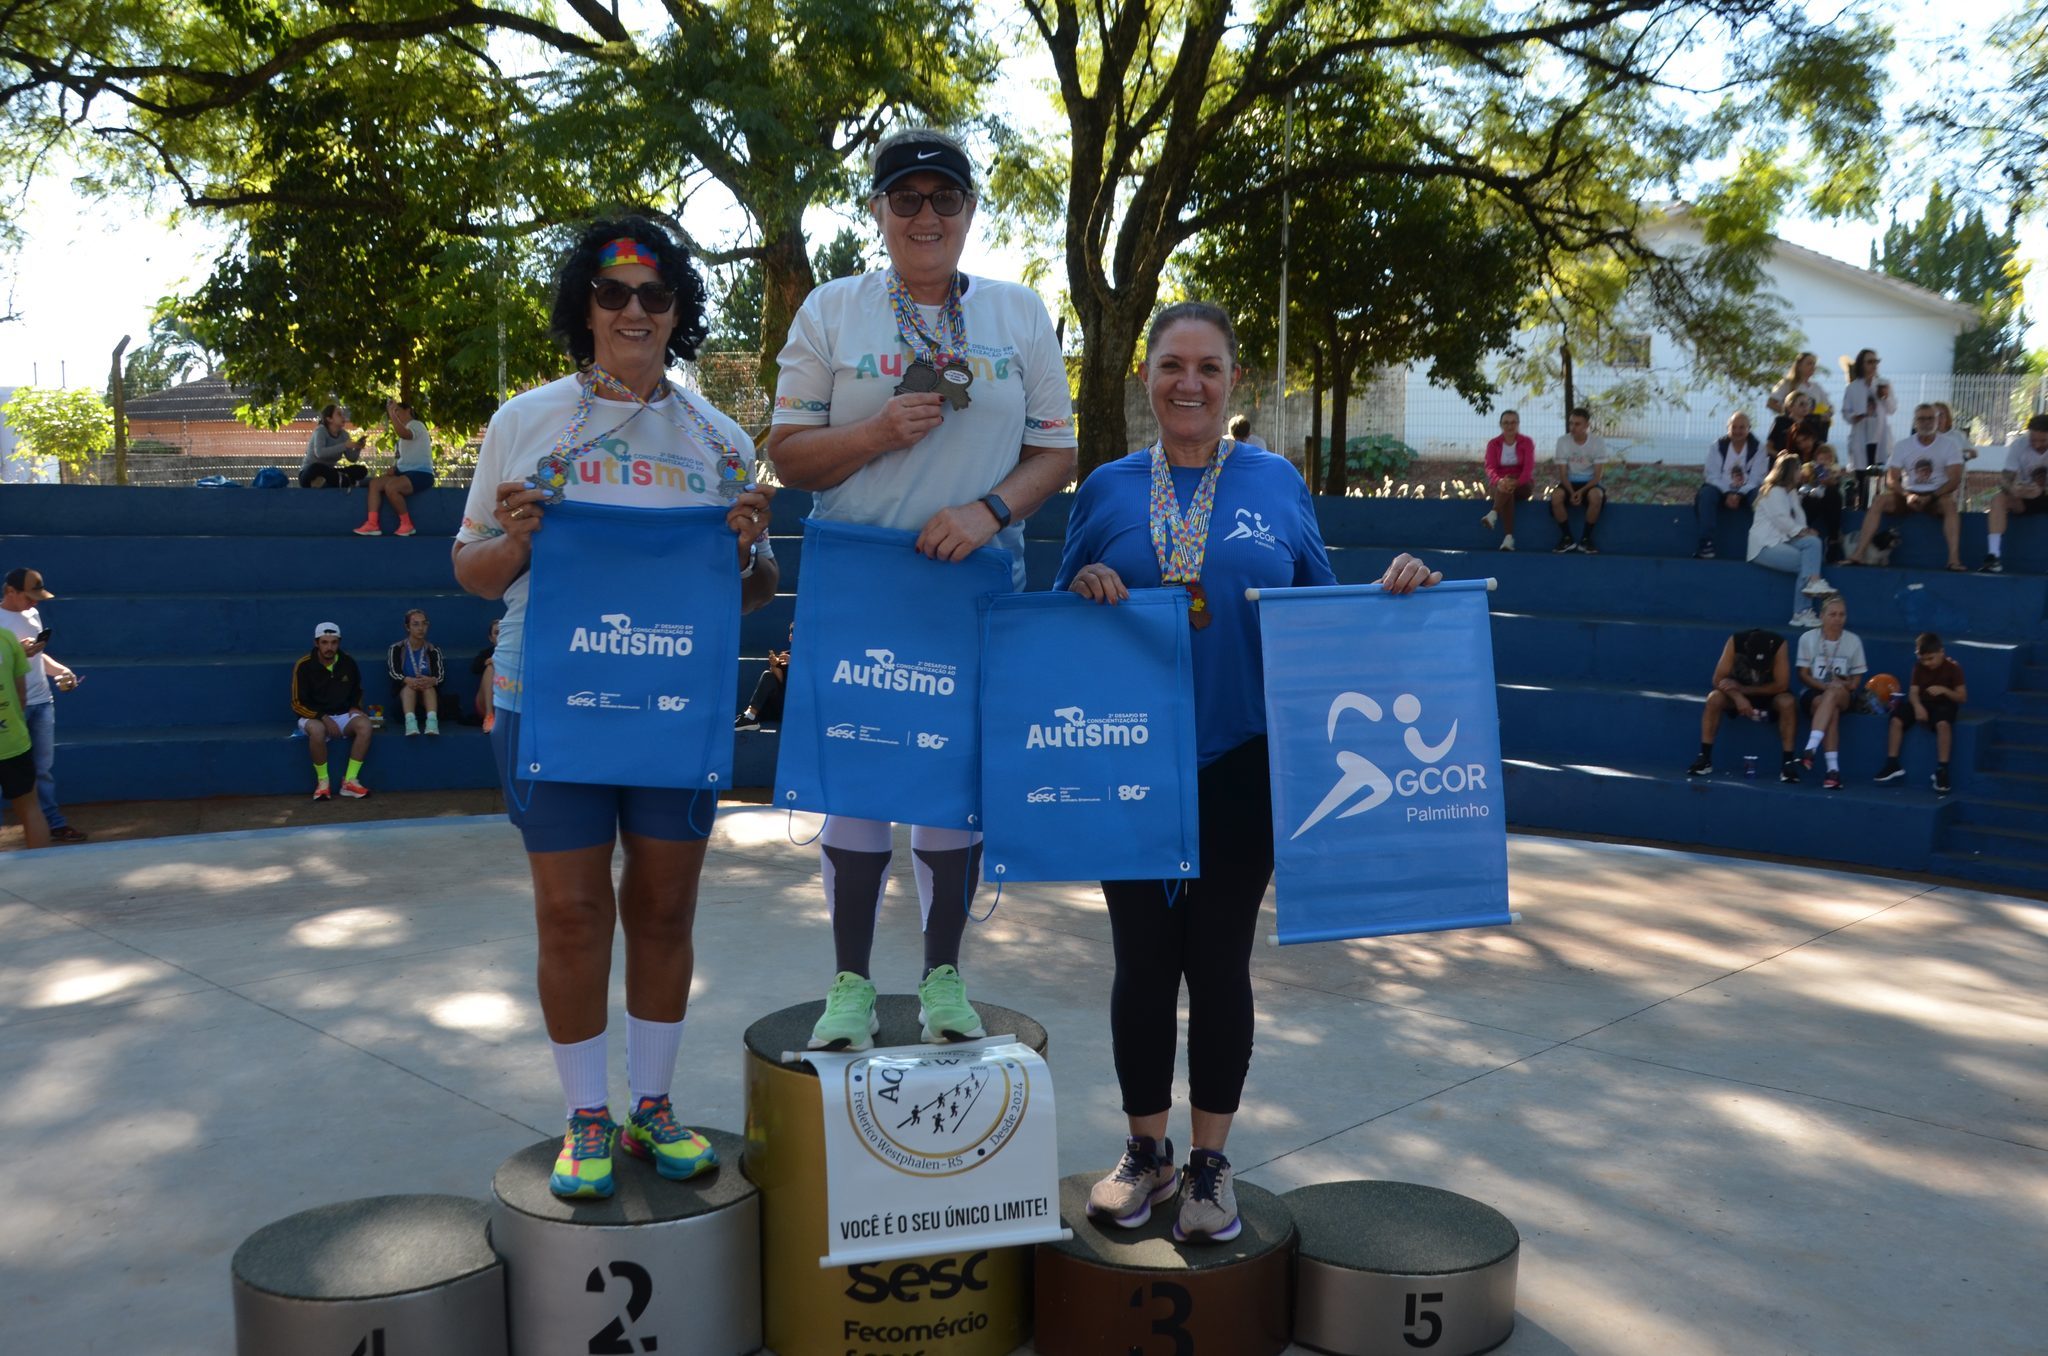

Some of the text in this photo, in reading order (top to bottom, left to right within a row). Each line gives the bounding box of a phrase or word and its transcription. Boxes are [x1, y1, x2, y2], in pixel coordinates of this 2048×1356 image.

[1252, 529, 1276, 544] GCOR
[569, 627, 693, 657] Autismo
[832, 660, 955, 696] Autismo
[1025, 722, 1149, 749] Autismo
[1395, 764, 1487, 797] GCOR
[1406, 802, 1490, 822] Palmitinho
[854, 1090, 878, 1142] Frederico
[989, 1082, 1023, 1145] Desde 2024
[841, 1197, 1048, 1240] VOCÊ É O SEU ÚNICO LIMITE!
[585, 1260, 658, 1356] 2
[1130, 1281, 1194, 1356] 3
[1402, 1292, 1443, 1348] 5
[844, 1311, 988, 1344] Fecomércio
